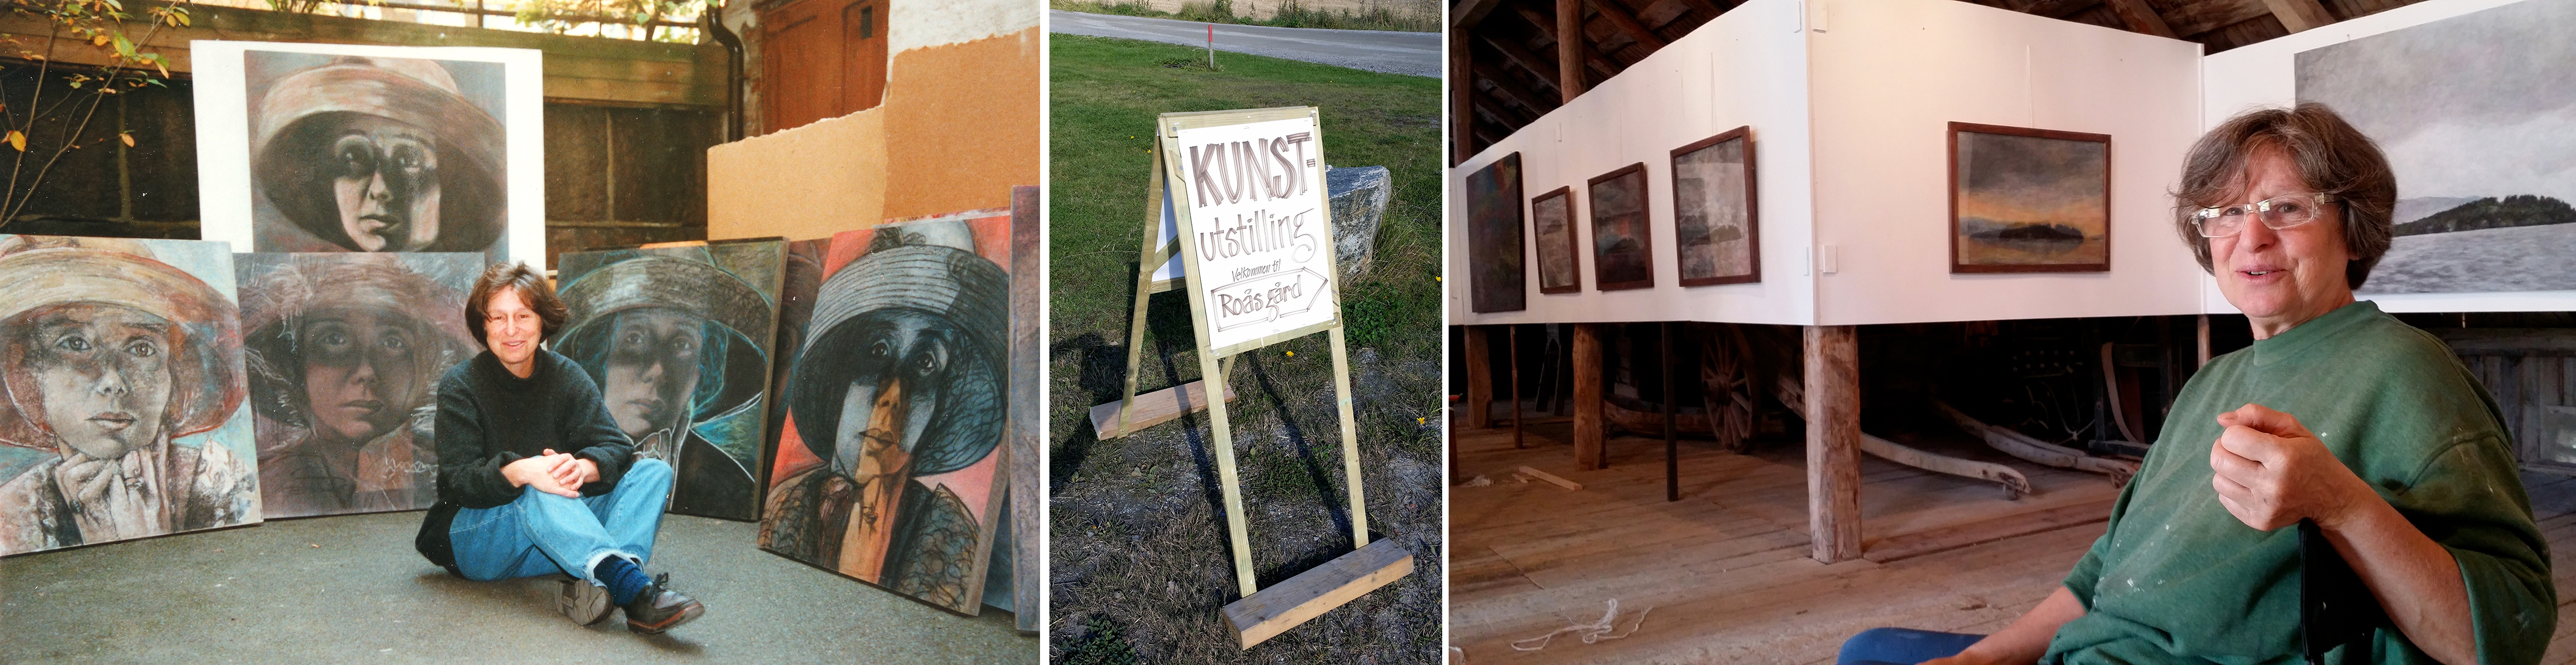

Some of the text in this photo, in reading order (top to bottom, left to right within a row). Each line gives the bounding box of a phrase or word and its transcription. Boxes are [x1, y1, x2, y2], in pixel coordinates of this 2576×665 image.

[1190, 132, 1316, 208] KUNST-
[1201, 208, 1318, 263] utstilling
[1232, 259, 1281, 282] Velkommen til
[1218, 274, 1302, 323] Roås gård
